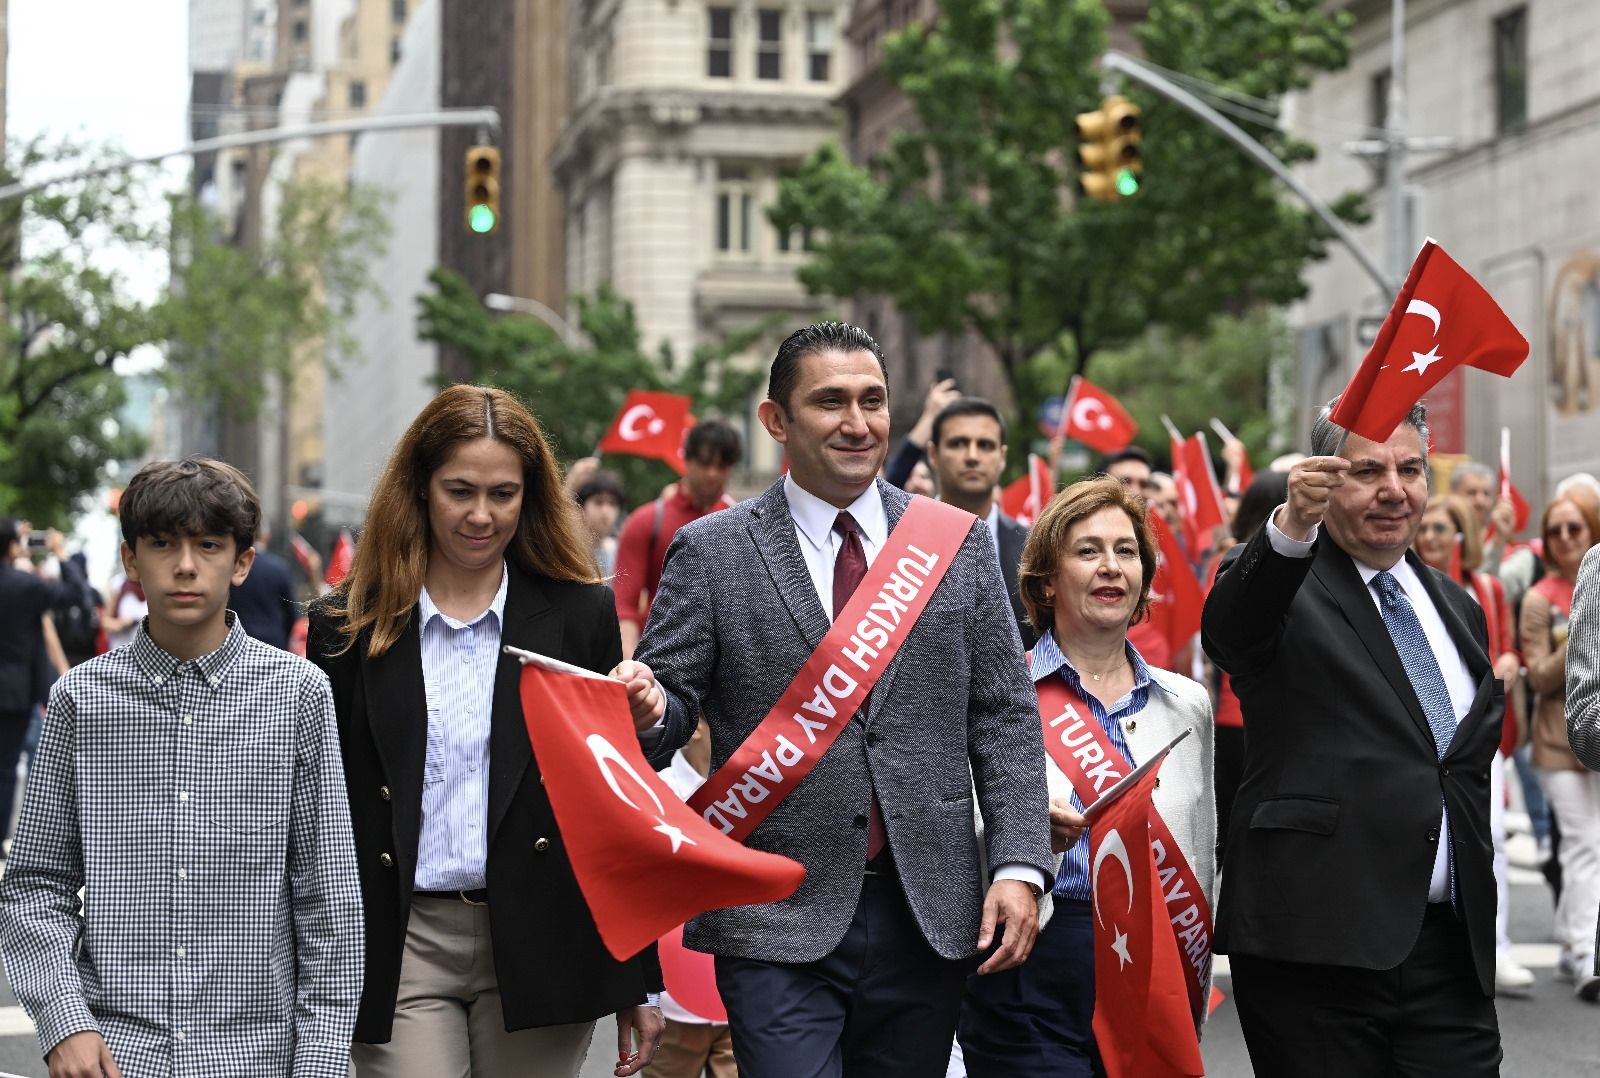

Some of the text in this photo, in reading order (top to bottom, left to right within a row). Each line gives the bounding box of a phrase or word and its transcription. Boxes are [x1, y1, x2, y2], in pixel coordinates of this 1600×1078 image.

[840, 543, 940, 672] TURKISH
[793, 663, 859, 744] DAY
[1049, 703, 1123, 798] TURK
[1171, 903, 1212, 992] PARAD
